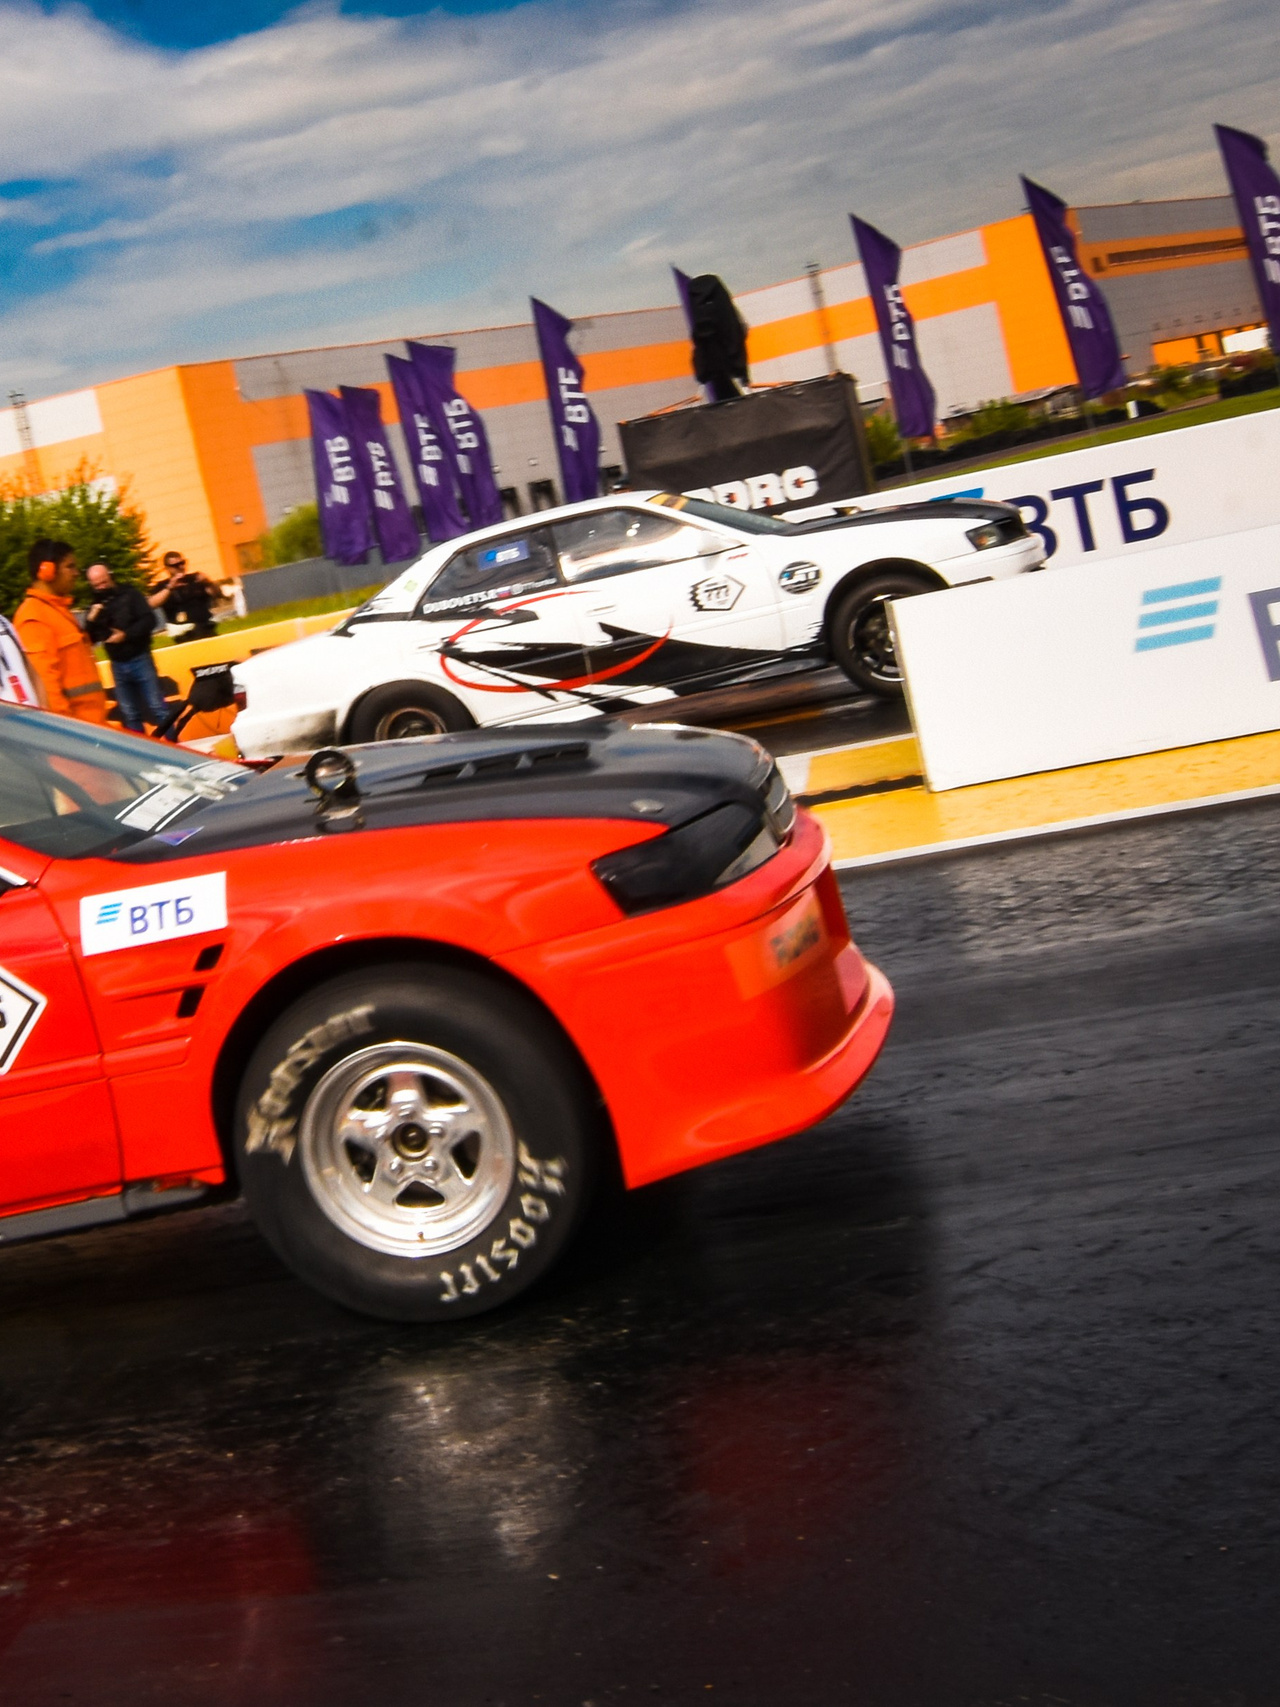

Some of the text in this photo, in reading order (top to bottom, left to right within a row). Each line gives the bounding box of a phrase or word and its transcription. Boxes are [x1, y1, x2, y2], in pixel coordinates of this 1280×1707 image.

[442, 398, 479, 450] ВТБ
[324, 435, 356, 482] ВТБ
[1001, 468, 1170, 560] ВТБ
[129, 896, 195, 935] ВТБ
